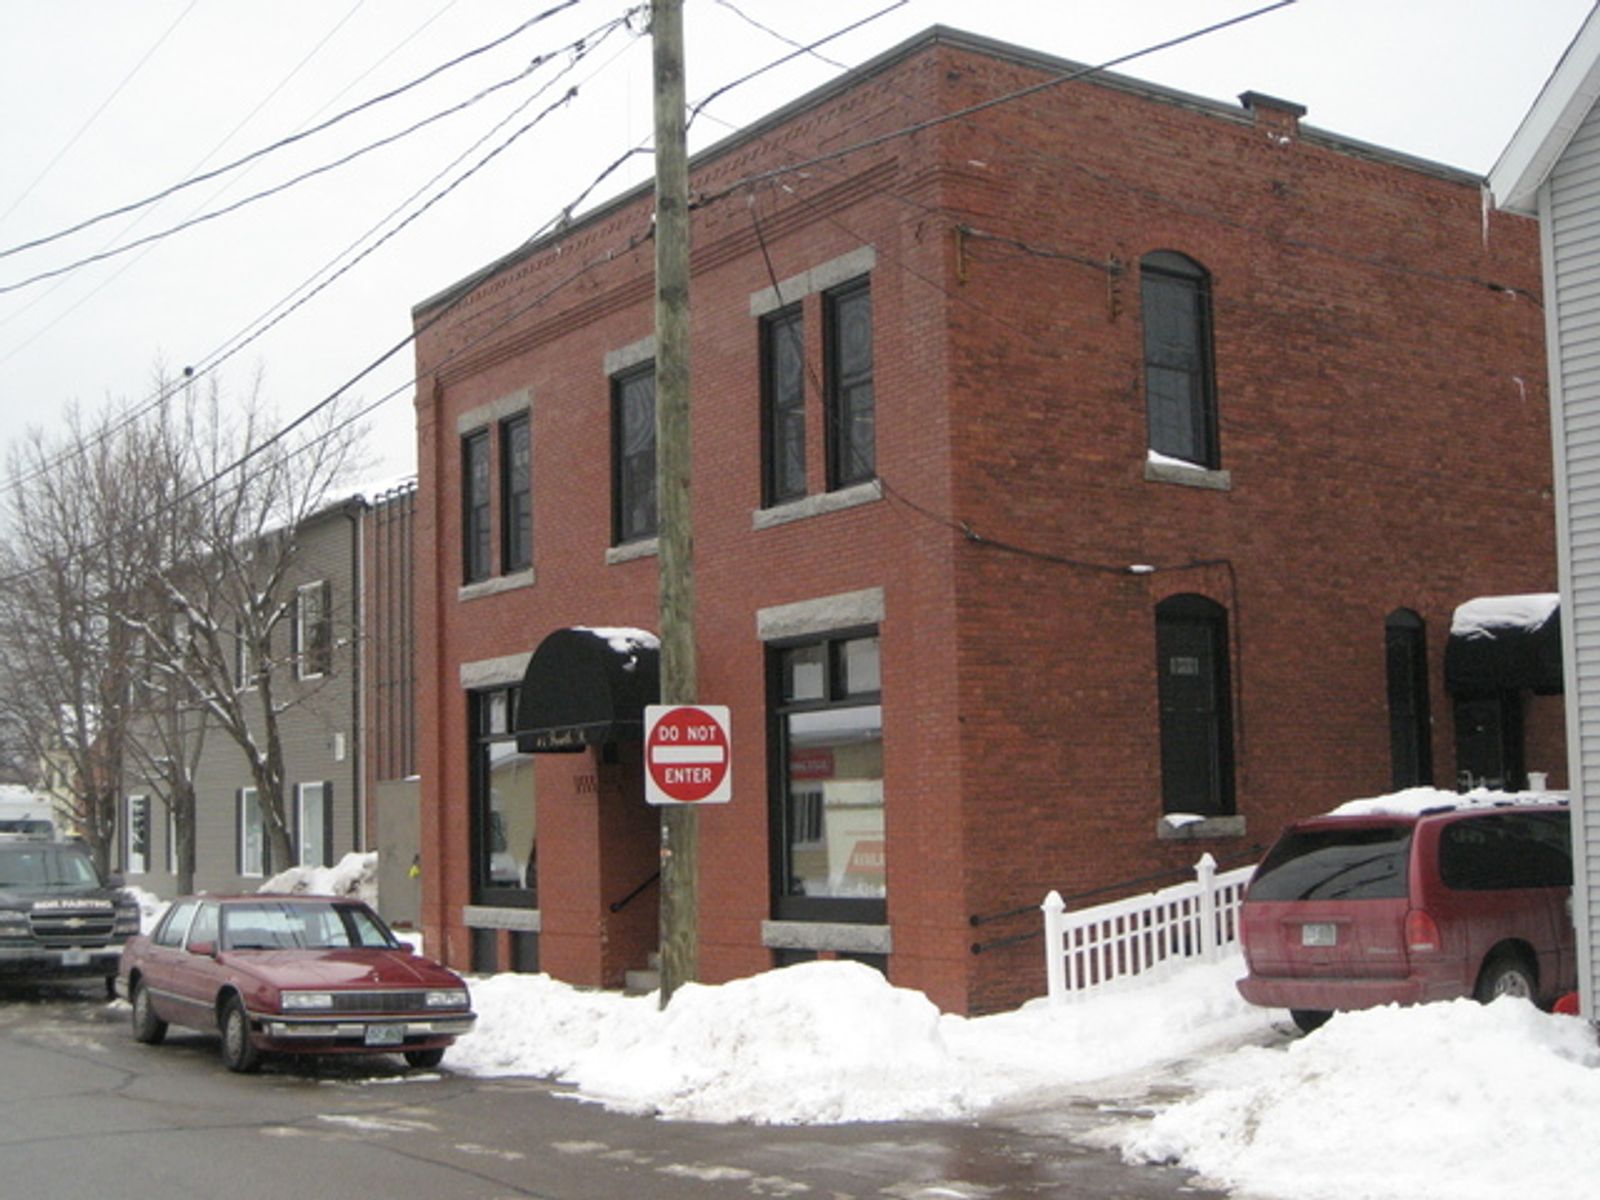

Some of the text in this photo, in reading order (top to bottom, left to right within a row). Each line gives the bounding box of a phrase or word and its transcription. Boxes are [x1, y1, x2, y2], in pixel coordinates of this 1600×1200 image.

[659, 726, 716, 741] DO NOT
[665, 768, 711, 783] ENTER
